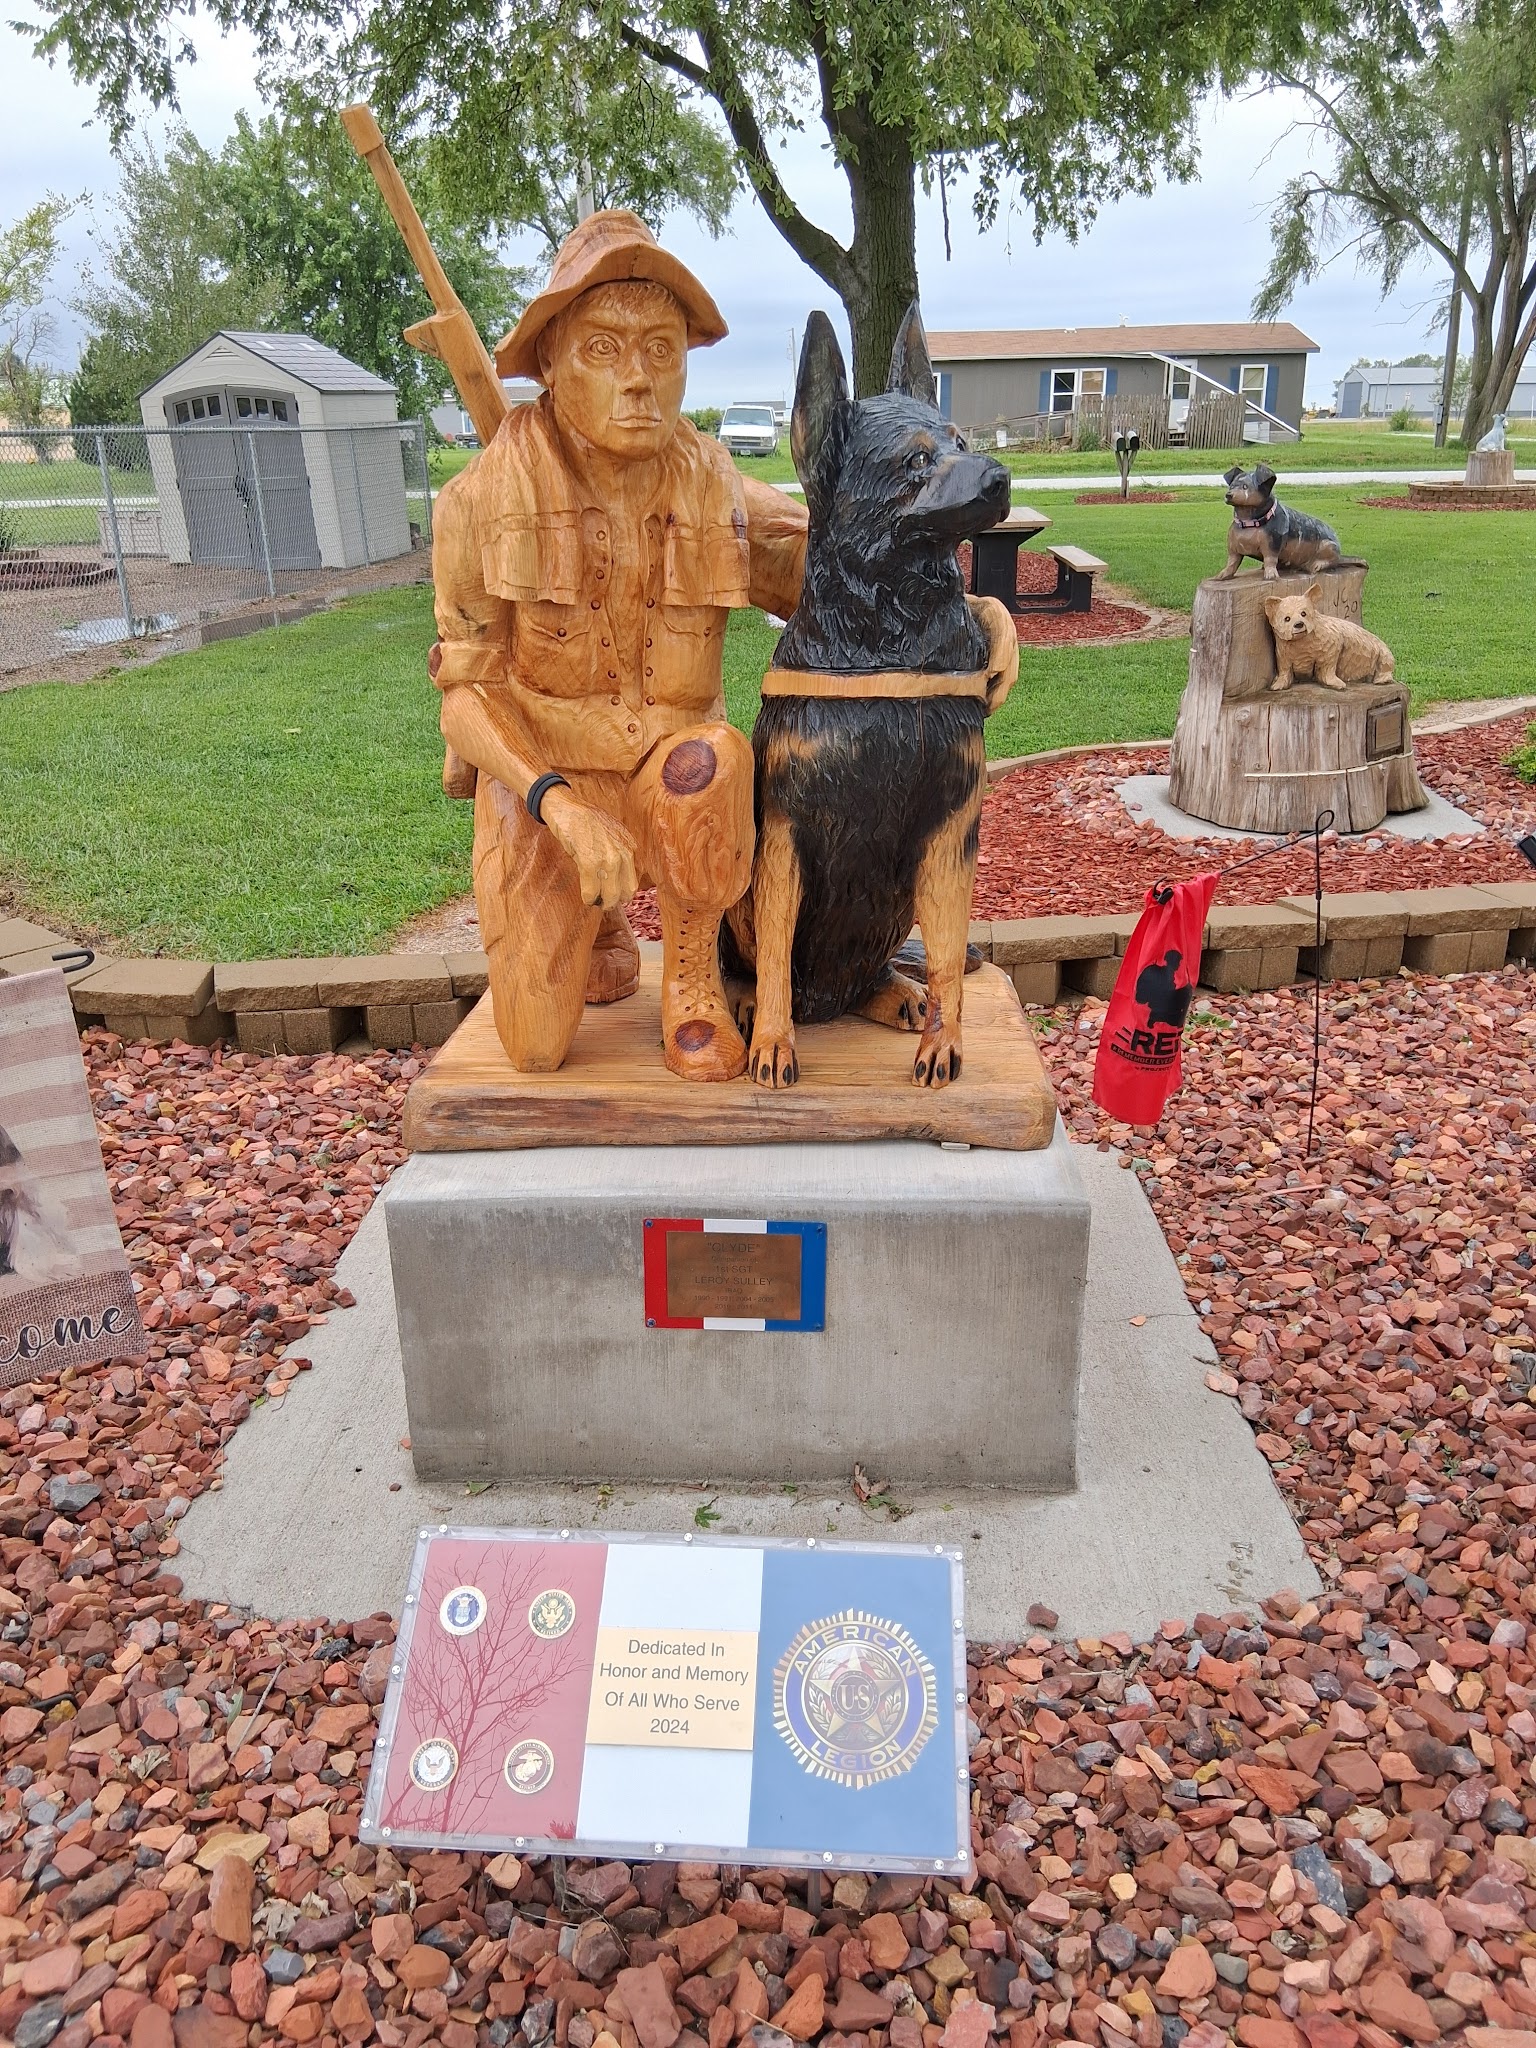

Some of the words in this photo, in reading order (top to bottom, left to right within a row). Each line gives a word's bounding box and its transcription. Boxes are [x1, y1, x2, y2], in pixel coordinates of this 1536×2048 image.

[1344, 600, 1358, 620] 20
[731, 1265, 753, 1274] SGT
[695, 1276, 730, 1285] LEROY
[733, 1277, 773, 1286] SULLEY
[628, 1639, 706, 1657] Dedicated
[711, 1642, 725, 1657] In
[794, 1625, 918, 1677] AMERICAN
[600, 1662, 648, 1679] Honor
[651, 1665, 681, 1680] and
[686, 1665, 749, 1686] Memory
[605, 1691, 624, 1707] Of
[628, 1692, 648, 1707] All
[653, 1693, 689, 1709] Who
[694, 1694, 740, 1711] Serve
[650, 1718, 690, 1734] 2024
[811, 1739, 902, 1769] LEGION
